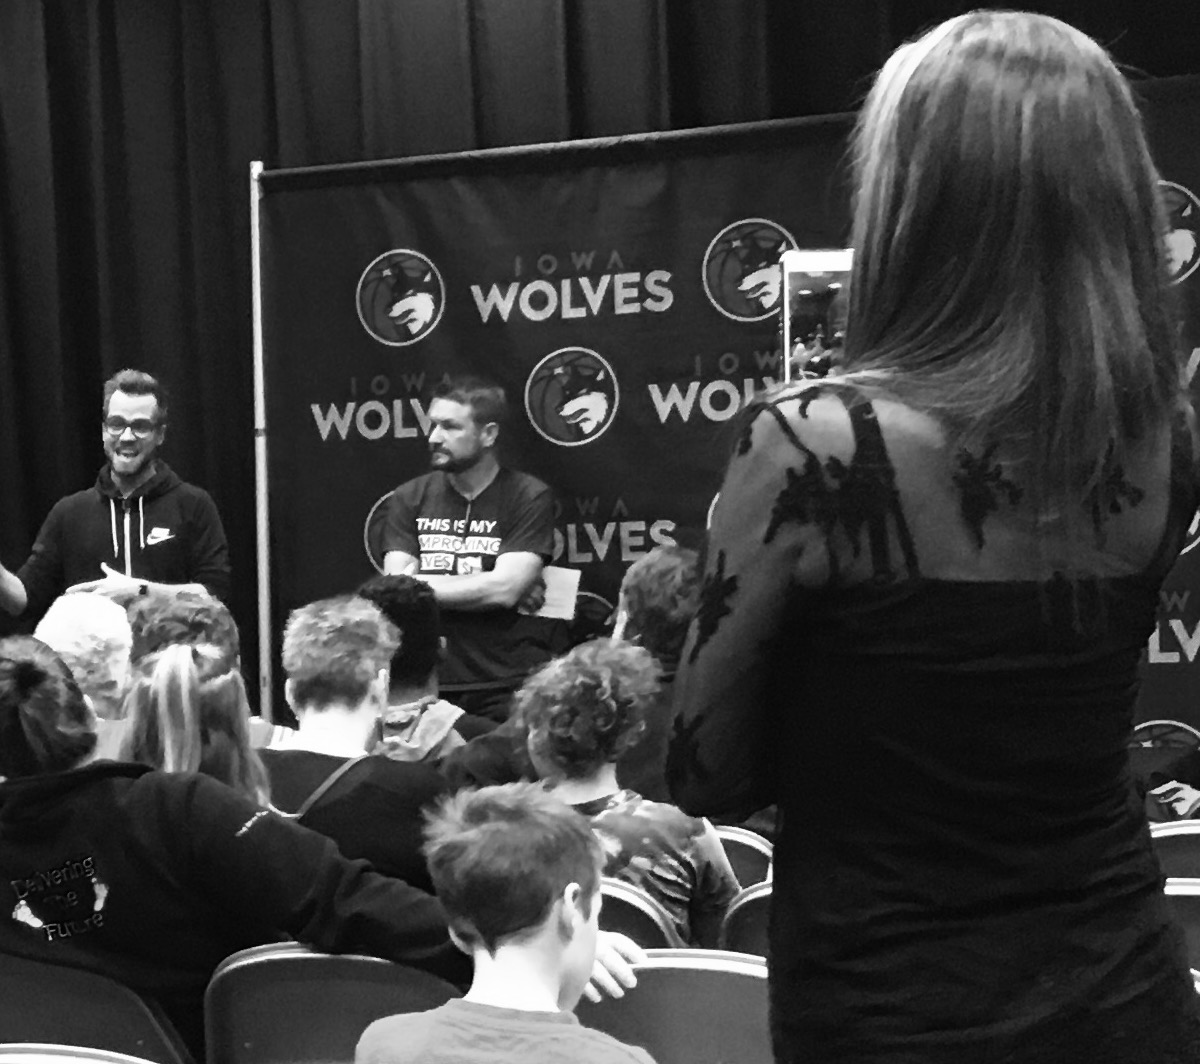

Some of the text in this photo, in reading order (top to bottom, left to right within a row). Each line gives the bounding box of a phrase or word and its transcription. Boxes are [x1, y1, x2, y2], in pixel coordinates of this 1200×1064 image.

[514, 250, 624, 277] IOWA
[470, 269, 674, 323] WOLVES
[694, 350, 781, 376] IOW
[310, 398, 433, 441] WOLV
[415, 517, 497, 534] THIS IS MY
[419, 535, 501, 552] MPROVING
[10, 856, 95, 899] Delivering
[43, 912, 104, 941] Future
